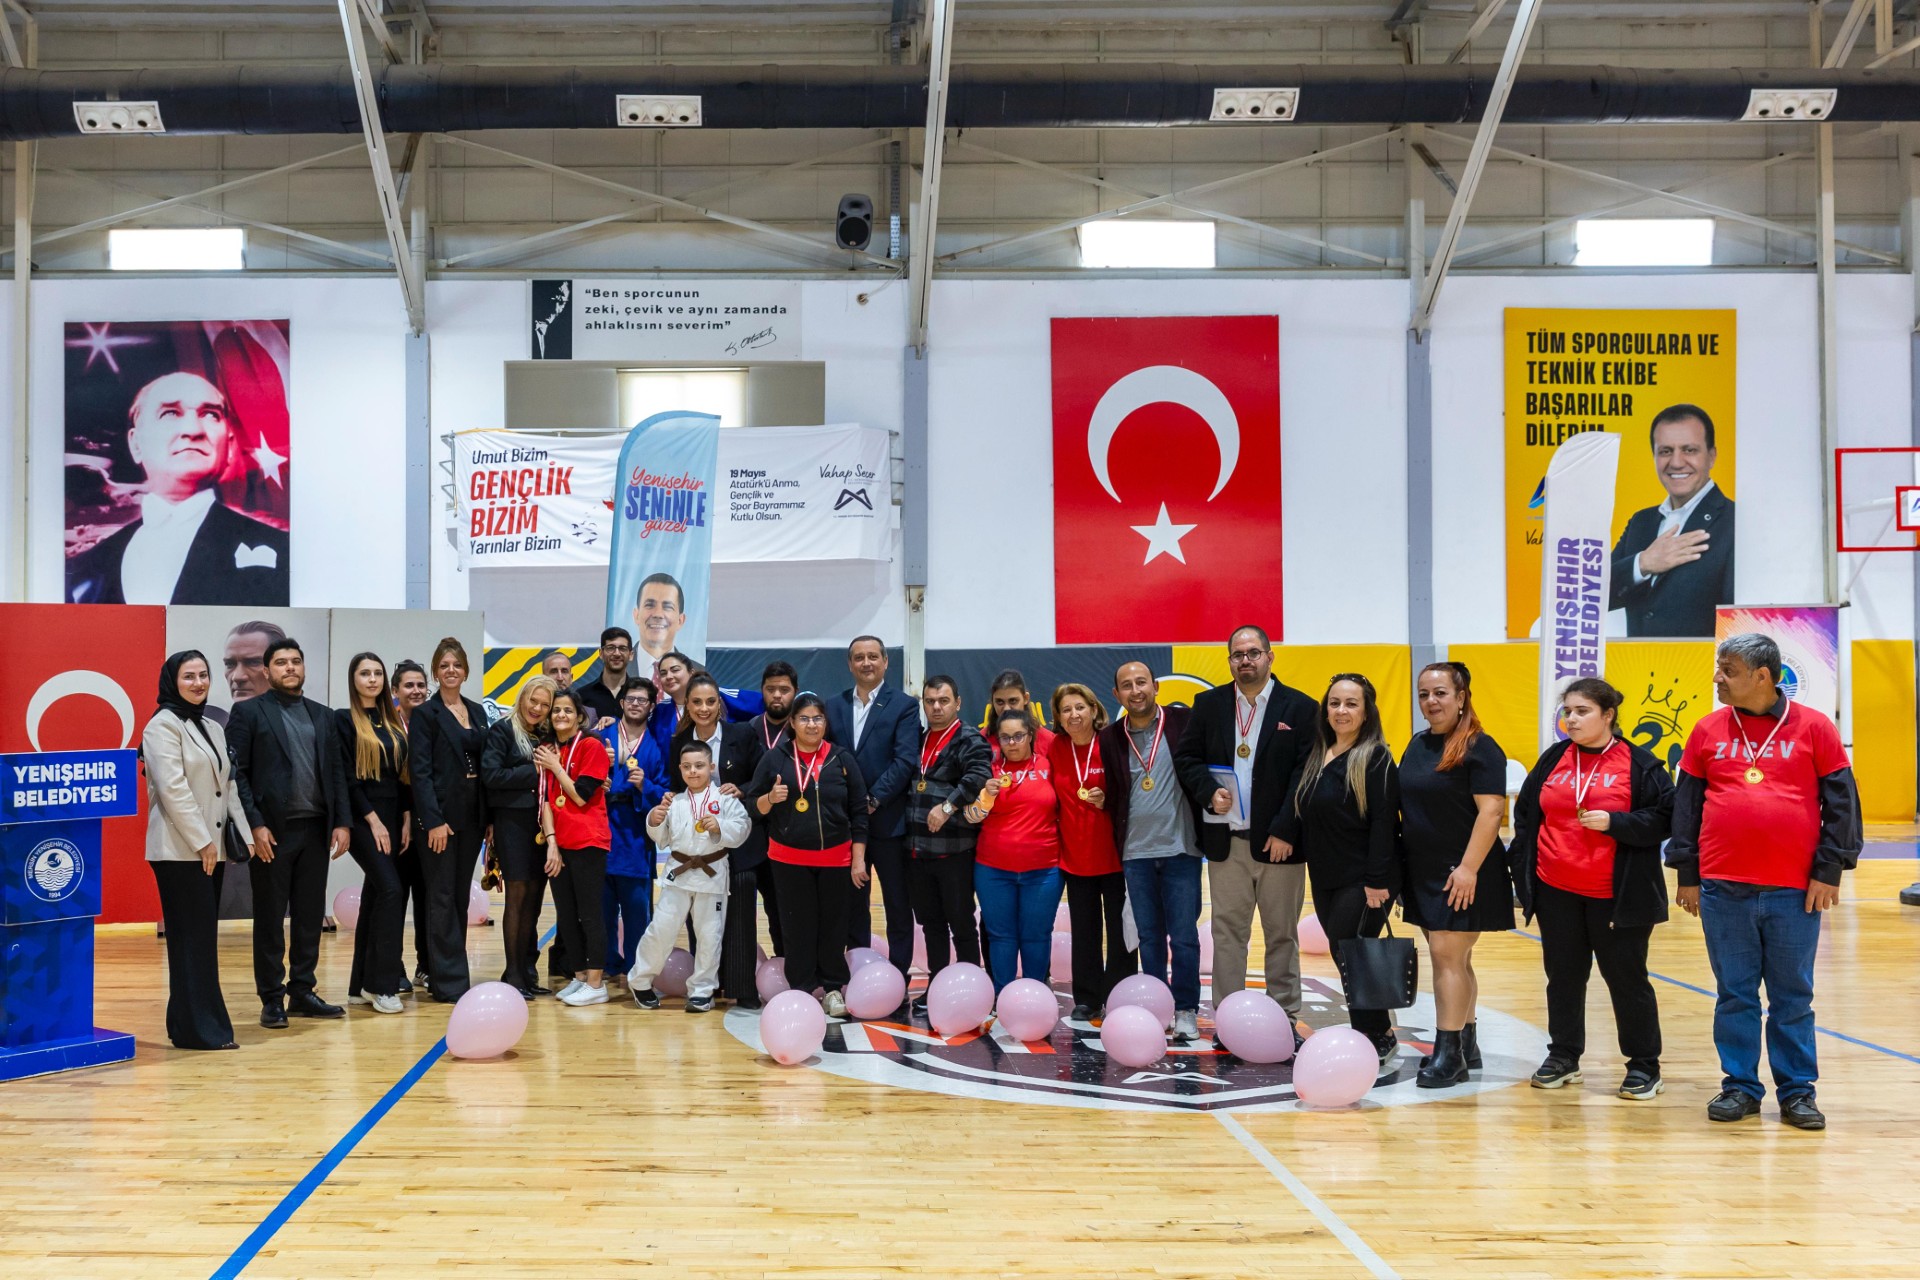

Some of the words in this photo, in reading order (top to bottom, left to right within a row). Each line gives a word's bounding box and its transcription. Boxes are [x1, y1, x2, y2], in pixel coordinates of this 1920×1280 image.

[624, 290, 700, 300] sporcunun
[585, 305, 620, 315] zeki,
[624, 305, 663, 316] çevik
[688, 307, 718, 316] aynı
[724, 305, 787, 314] zamanda
[585, 321, 662, 330] ahlaklısını
[1526, 328, 1565, 354] TÜM
[1572, 332, 1692, 355] SPORCULARA
[1697, 333, 1719, 355] VE
[1526, 358, 1596, 385] TEKNİK
[1602, 358, 1658, 386] EKİBE
[1526, 392, 1633, 419] BAŞARILAR
[472, 449, 508, 464] Umut
[511, 447, 548, 463] Bizim
[470, 461, 574, 504] GENÇLİK
[730, 469, 739, 478] 19
[740, 469, 766, 480] Mayıs
[819, 463, 853, 484] Vahap
[772, 479, 800, 488] Anma,
[730, 490, 762, 501] Gençlik
[730, 502, 752, 512] Spor
[753, 501, 806, 511] Bayramımız
[470, 500, 539, 537] BİZİM
[730, 512, 754, 521] Kutlu
[755, 511, 782, 521] Olsun.
[640, 517, 688, 539] güzel
[470, 538, 521, 555] Yarınlar
[524, 535, 561, 551] Bizim
[1714, 738, 1795, 763] ZİÇEV
